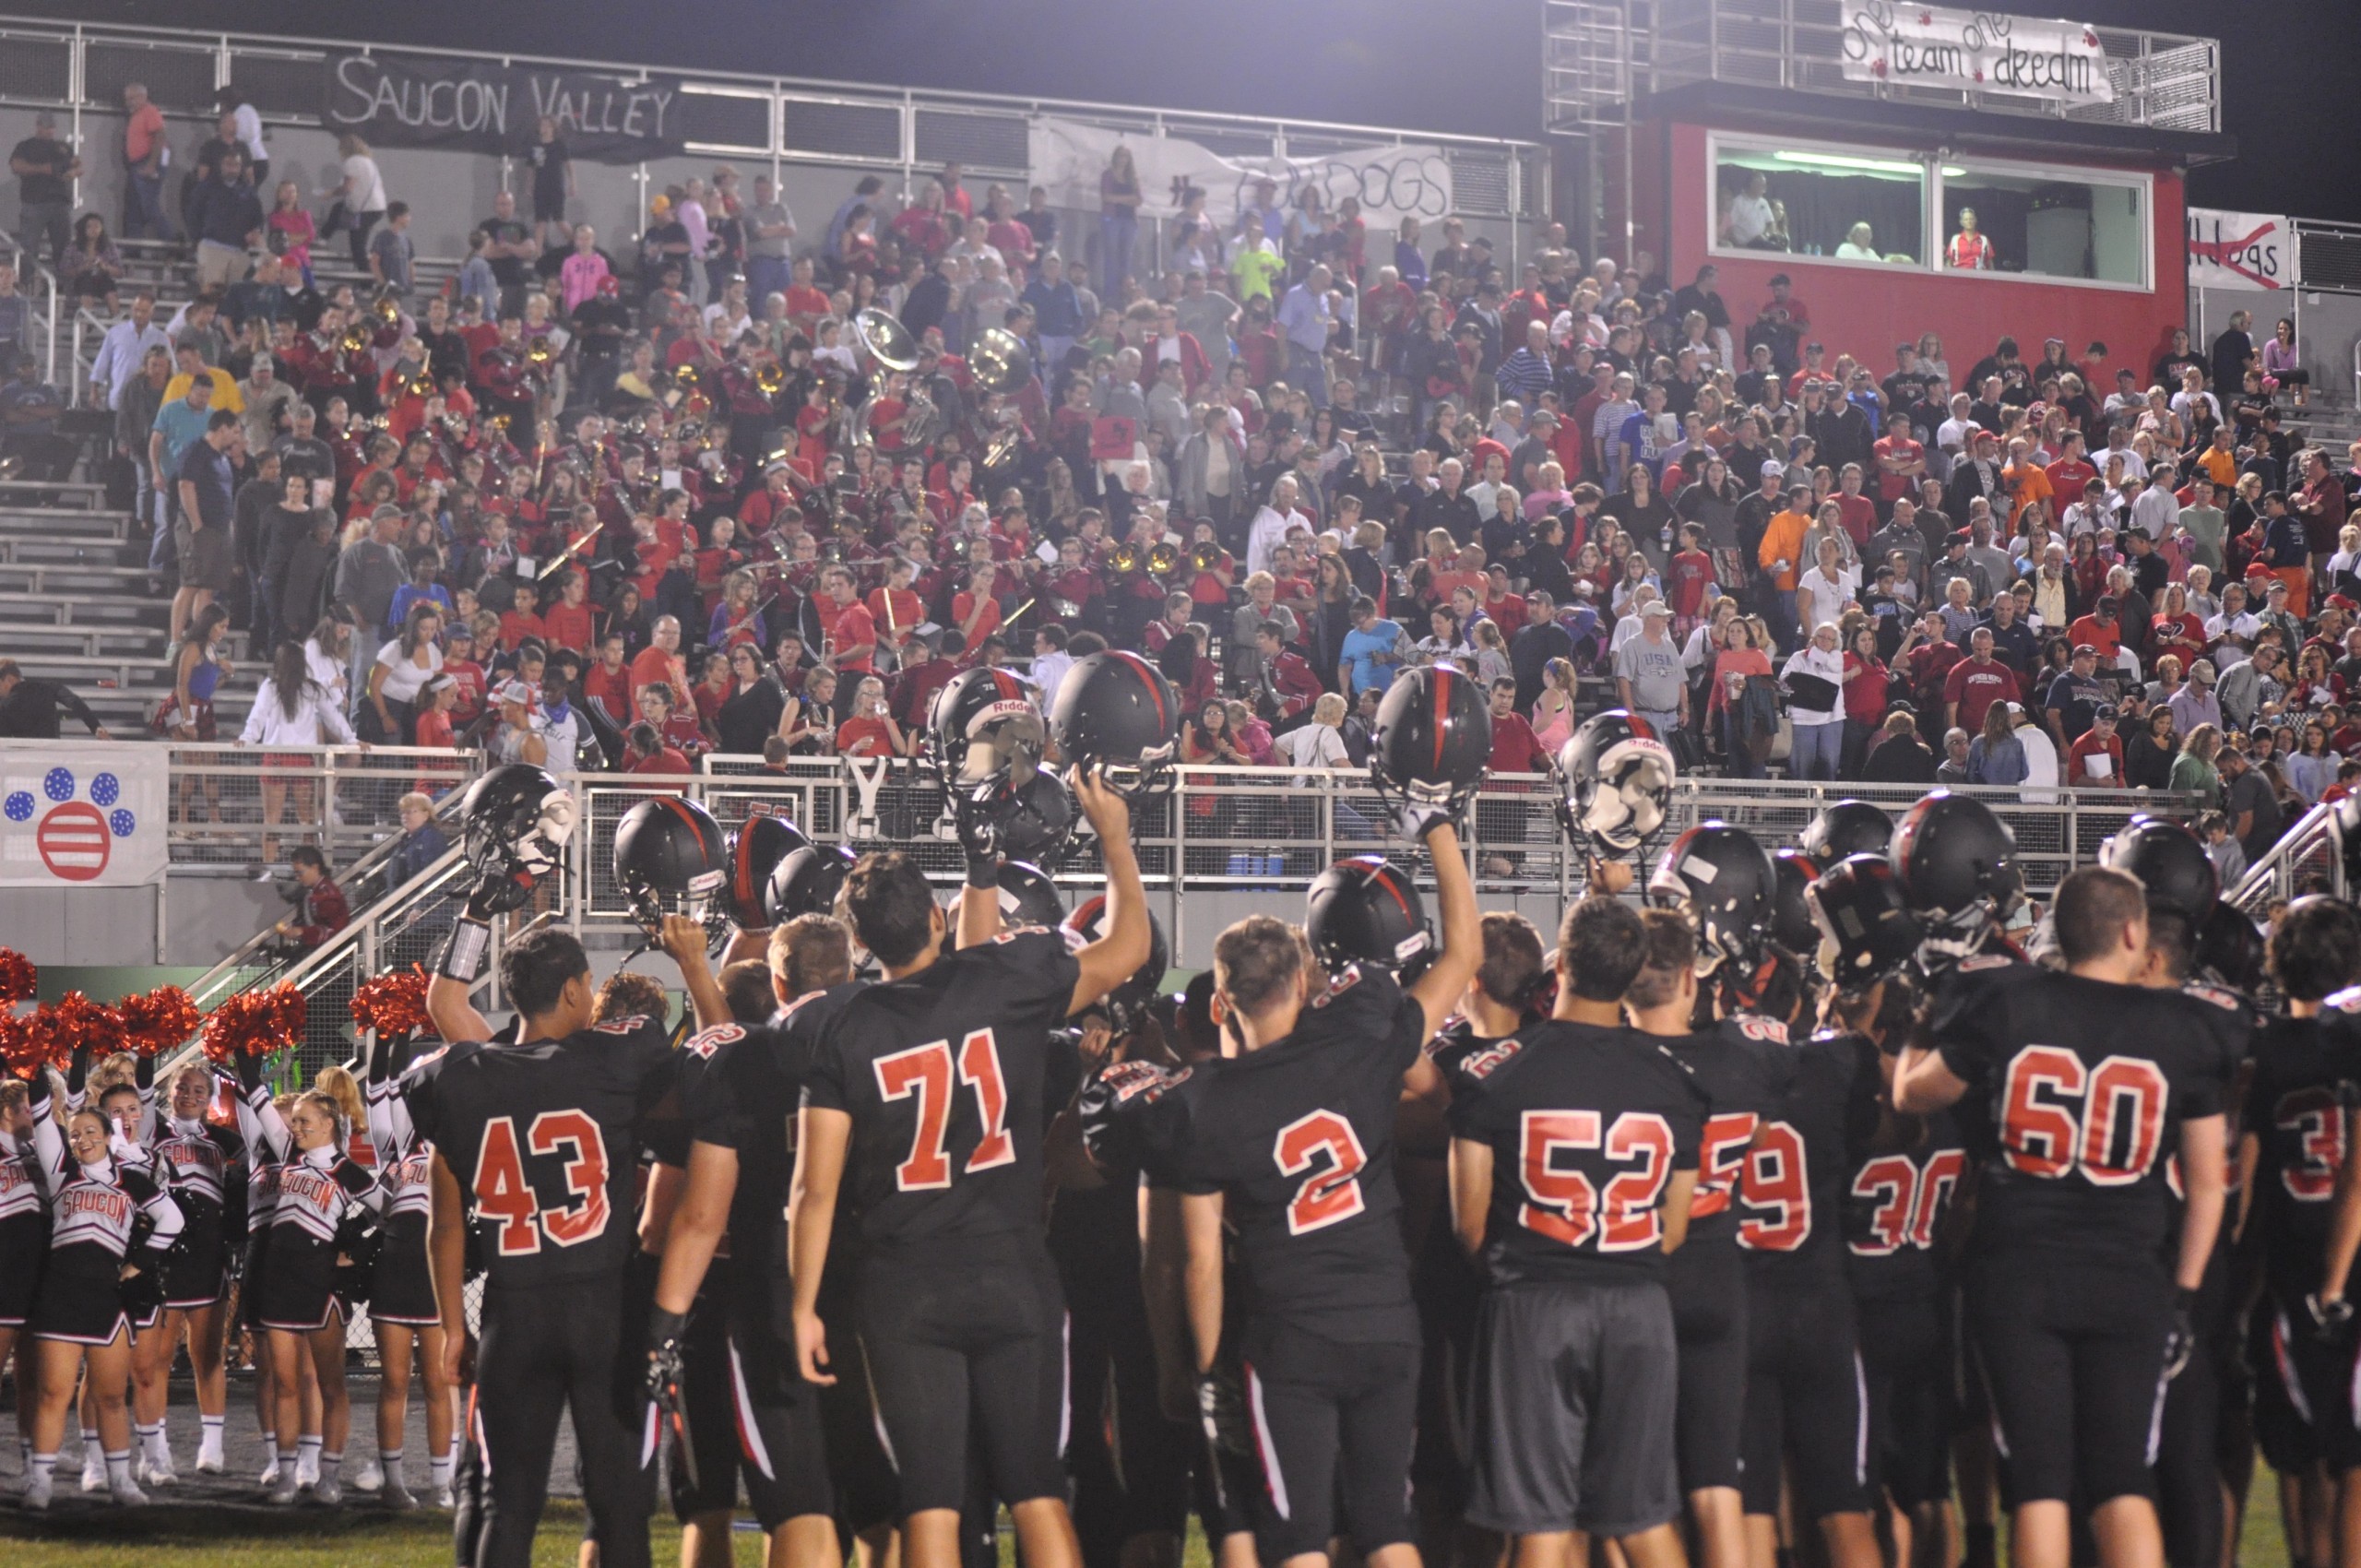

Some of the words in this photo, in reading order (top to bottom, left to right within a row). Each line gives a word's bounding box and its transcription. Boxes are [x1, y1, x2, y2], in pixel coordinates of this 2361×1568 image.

[331, 56, 507, 136] SAUCON
[530, 77, 673, 138] VALLEY
[1844, 0, 1894, 61] one
[1892, 29, 1964, 78] team
[1963, 11, 2011, 53] one
[1643, 652, 1674, 666] USA
[872, 1027, 1016, 1192] 71
[1273, 1108, 1368, 1236] 2
[1999, 1044, 2169, 1186] 60
[61, 1189, 130, 1229] SAUCON
[471, 1108, 611, 1256] 43
[1518, 1109, 1675, 1253] 52
